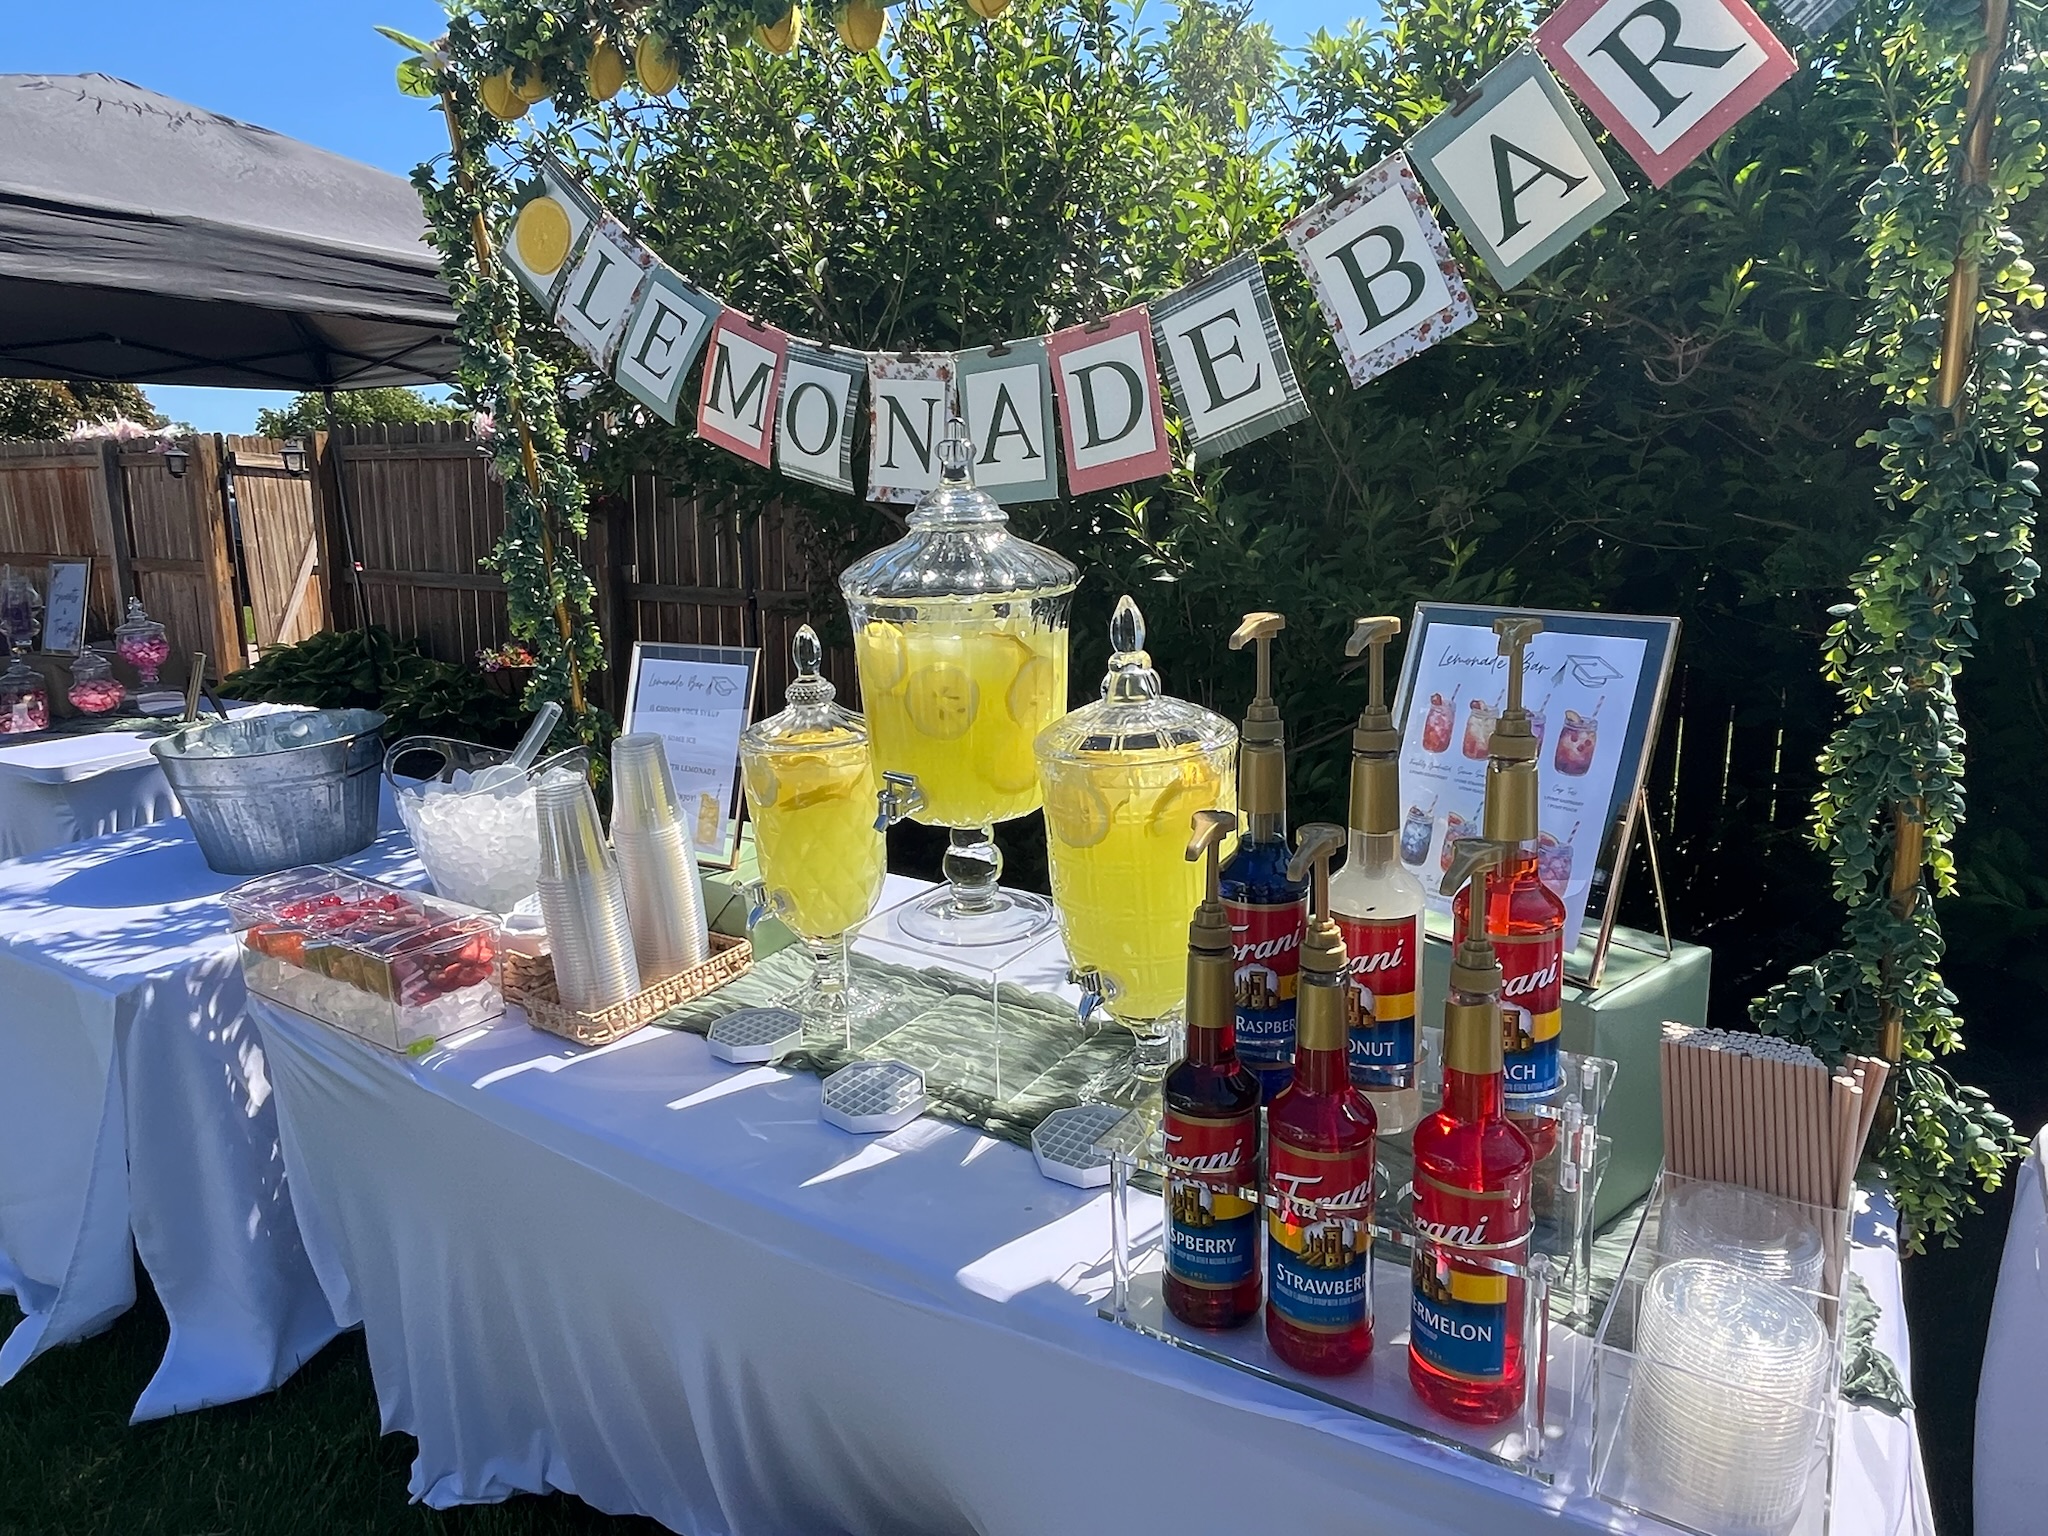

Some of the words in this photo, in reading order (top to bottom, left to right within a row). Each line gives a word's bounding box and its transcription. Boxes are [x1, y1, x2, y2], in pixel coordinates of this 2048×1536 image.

[1325, 0, 1747, 337] BAR
[1438, 645, 1508, 675] Lemonade
[680, 764, 717, 776] LEMONADE
[1235, 1014, 1297, 1034] RASPBER
[1349, 1038, 1395, 1057] ONUT
[1503, 1063, 1536, 1080] ACH
[1170, 1226, 1237, 1255] SPBERRY
[1277, 1262, 1366, 1296] STRAWBERR
[1412, 1293, 1492, 1343] ERMELON
